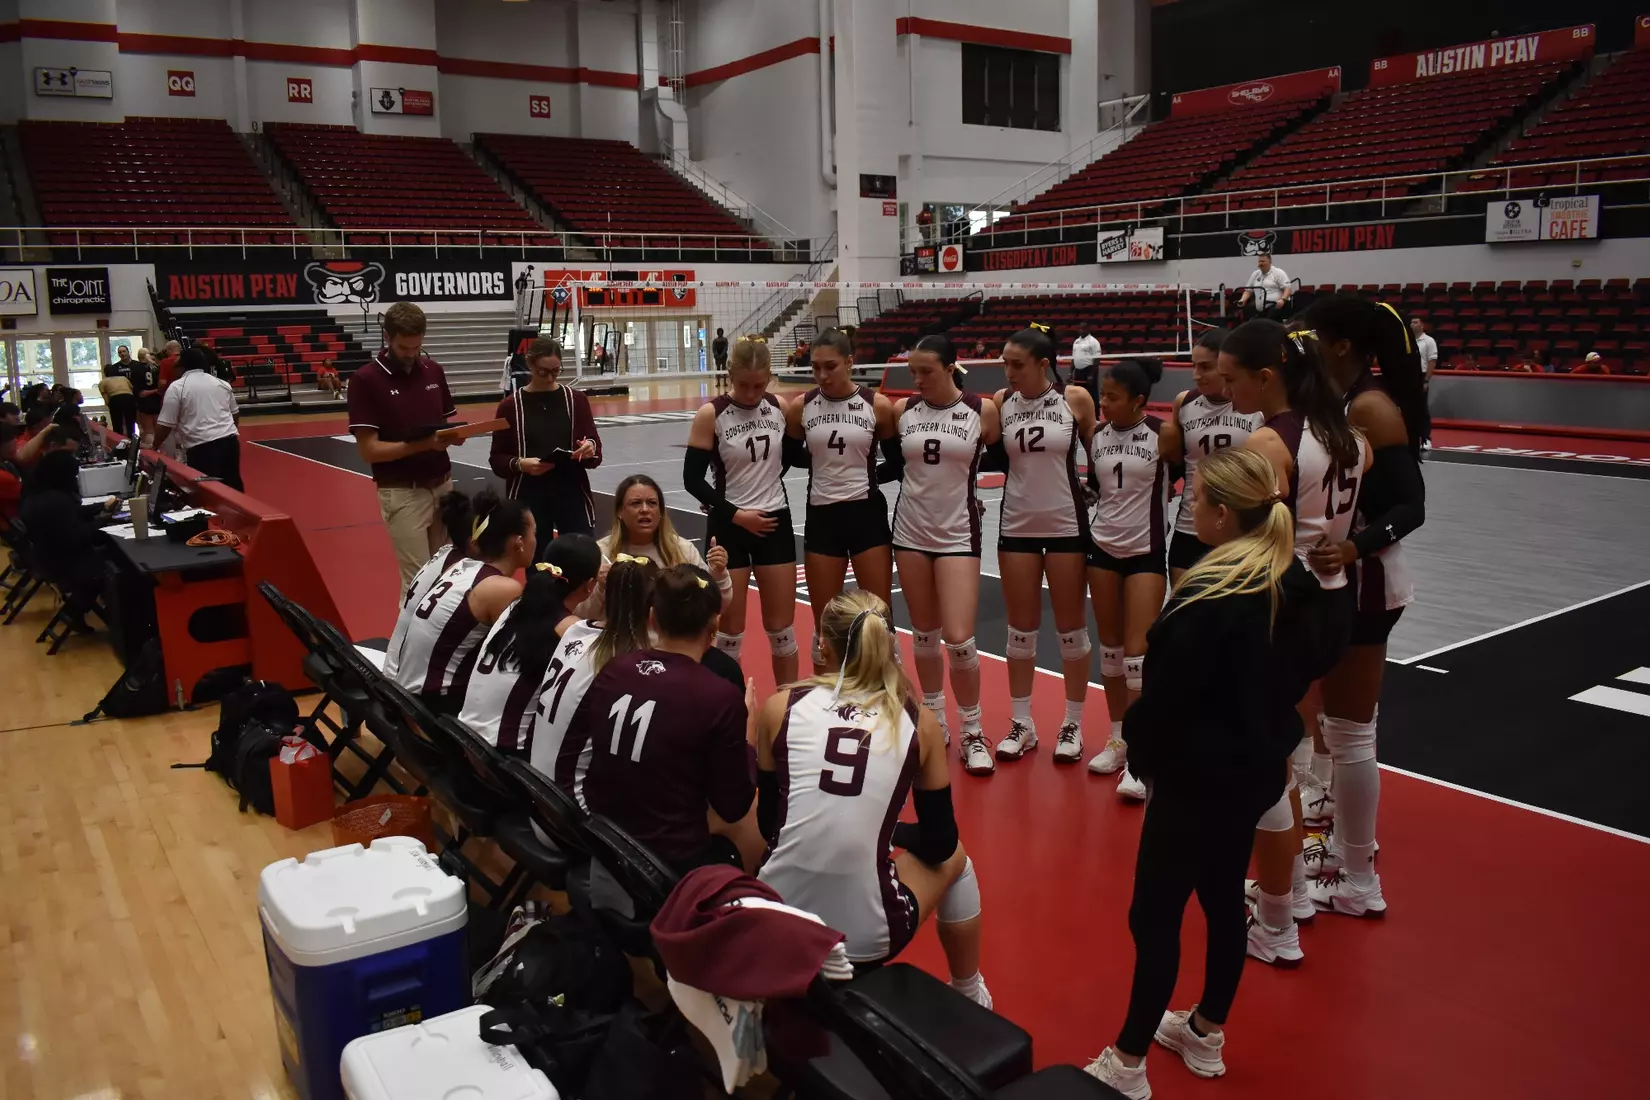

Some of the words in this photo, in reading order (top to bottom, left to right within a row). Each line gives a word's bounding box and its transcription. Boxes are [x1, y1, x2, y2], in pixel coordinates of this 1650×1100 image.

[1572, 27, 1589, 39] BB
[1374, 60, 1388, 70] BB
[1416, 45, 1486, 78] AUSTIN
[1490, 36, 1540, 67] PEAY
[169, 76, 194, 92] QQ
[1328, 70, 1338, 79] AA
[288, 83, 311, 98] RR
[1171, 96, 1182, 104] AA
[531, 100, 549, 113] SS
[1551, 197, 1588, 210] tropical
[1291, 227, 1350, 253] AUSTIN
[1354, 224, 1395, 250] PEAY
[1550, 219, 1588, 239] CAFE
[51, 278, 68, 287] THE
[67, 280, 104, 296] JOINT
[169, 273, 244, 299] AUSTIN
[249, 273, 297, 298] PEAY
[395, 271, 505, 296] GOVERNORS
[53, 296, 106, 305] chiropractic
[145, 371, 153, 386] 9
[807, 413, 840, 431] SOUTHERN
[841, 413, 868, 430] ILLINOIS
[1035, 410, 1063, 425] ILLINOIS
[1185, 416, 1221, 432] SOUTHERN
[1222, 416, 1252, 433] ILLINOIS
[725, 418, 758, 441] SOUTHERN
[906, 421, 939, 436] SOUTHERN
[941, 422, 969, 441] ILLINOIS
[1015, 427, 1045, 452] 12
[746, 435, 770, 462] 17
[828, 430, 846, 456] 4
[923, 439, 941, 465] 8
[1124, 444, 1152, 462] ILLINOIS
[1113, 461, 1122, 488] 1
[1322, 463, 1357, 520] 15
[537, 657, 575, 724] 21
[608, 693, 656, 763] 11
[819, 727, 871, 797] 9
